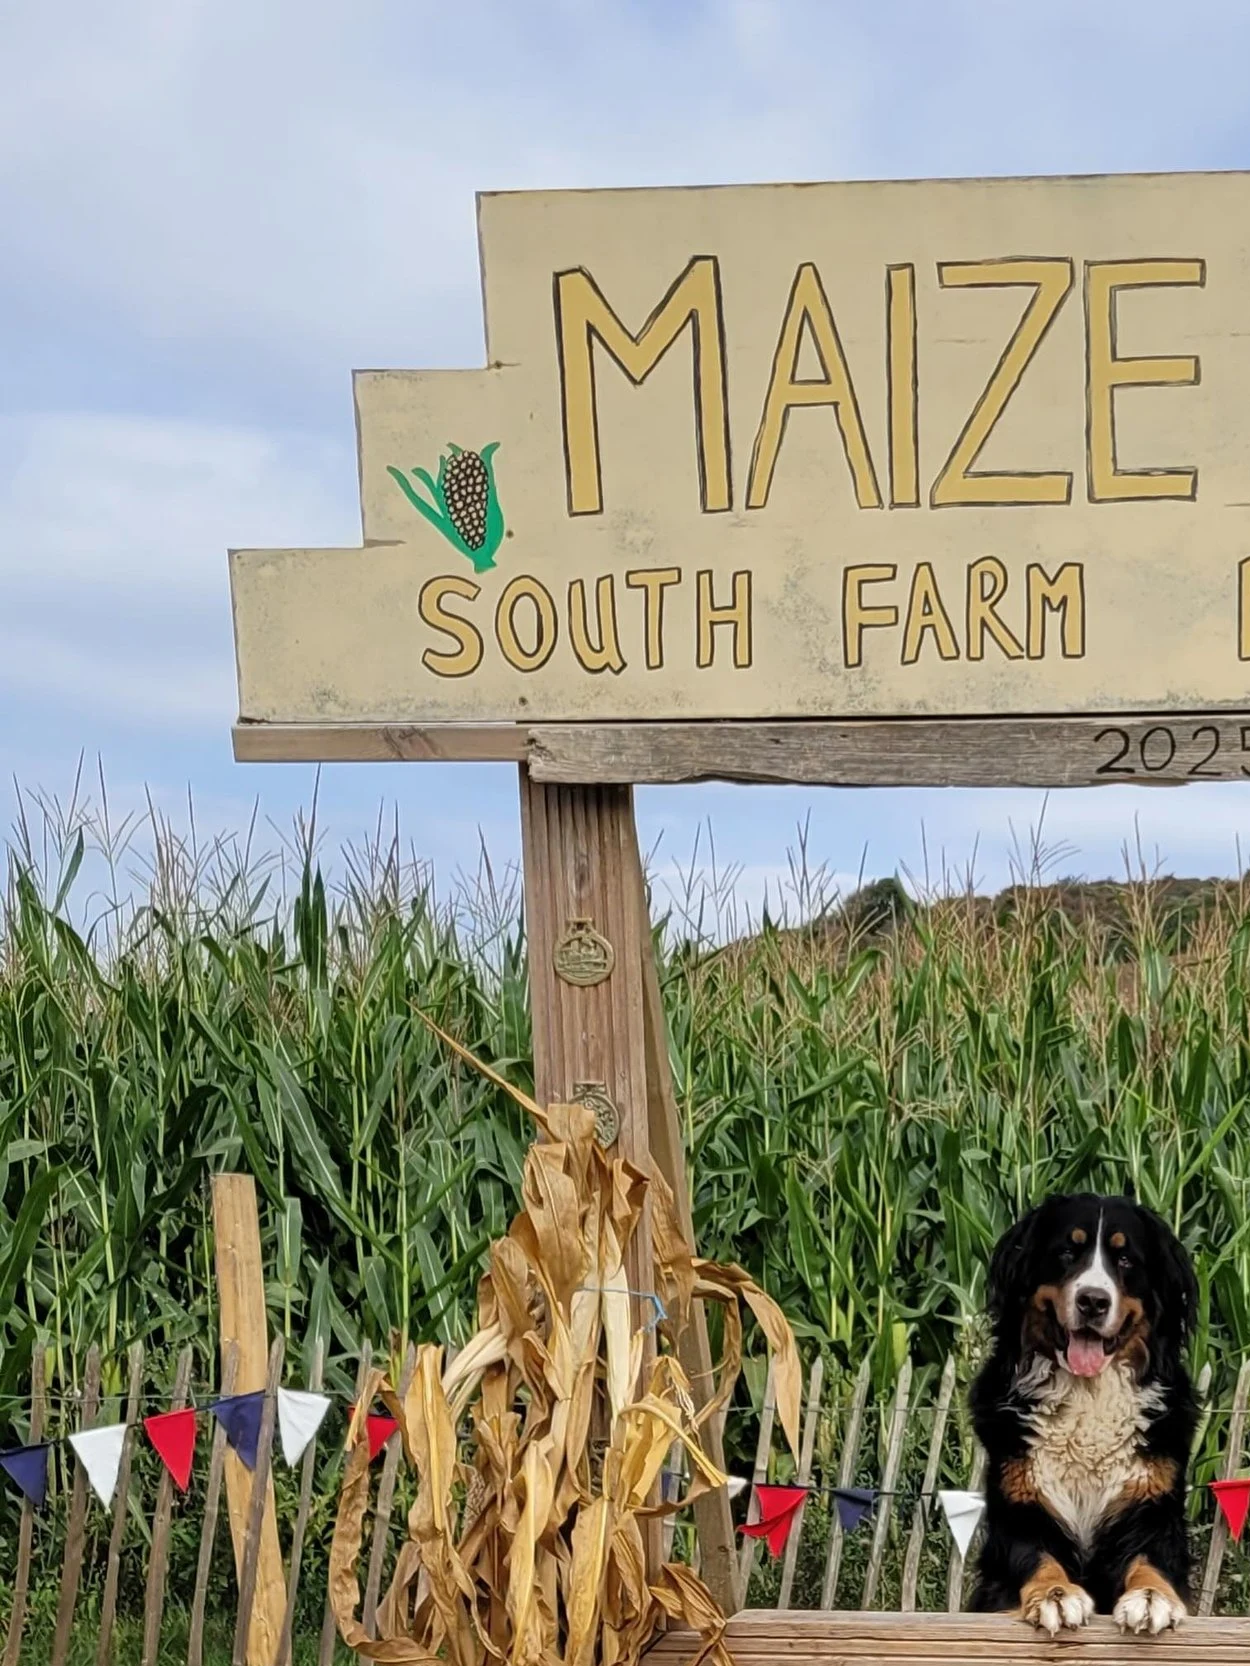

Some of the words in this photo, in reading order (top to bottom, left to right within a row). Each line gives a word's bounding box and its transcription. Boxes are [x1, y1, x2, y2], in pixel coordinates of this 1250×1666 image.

[553, 255, 1205, 515] MAIZE
[418, 566, 752, 677] SOUTH
[843, 556, 1085, 668] FARM
